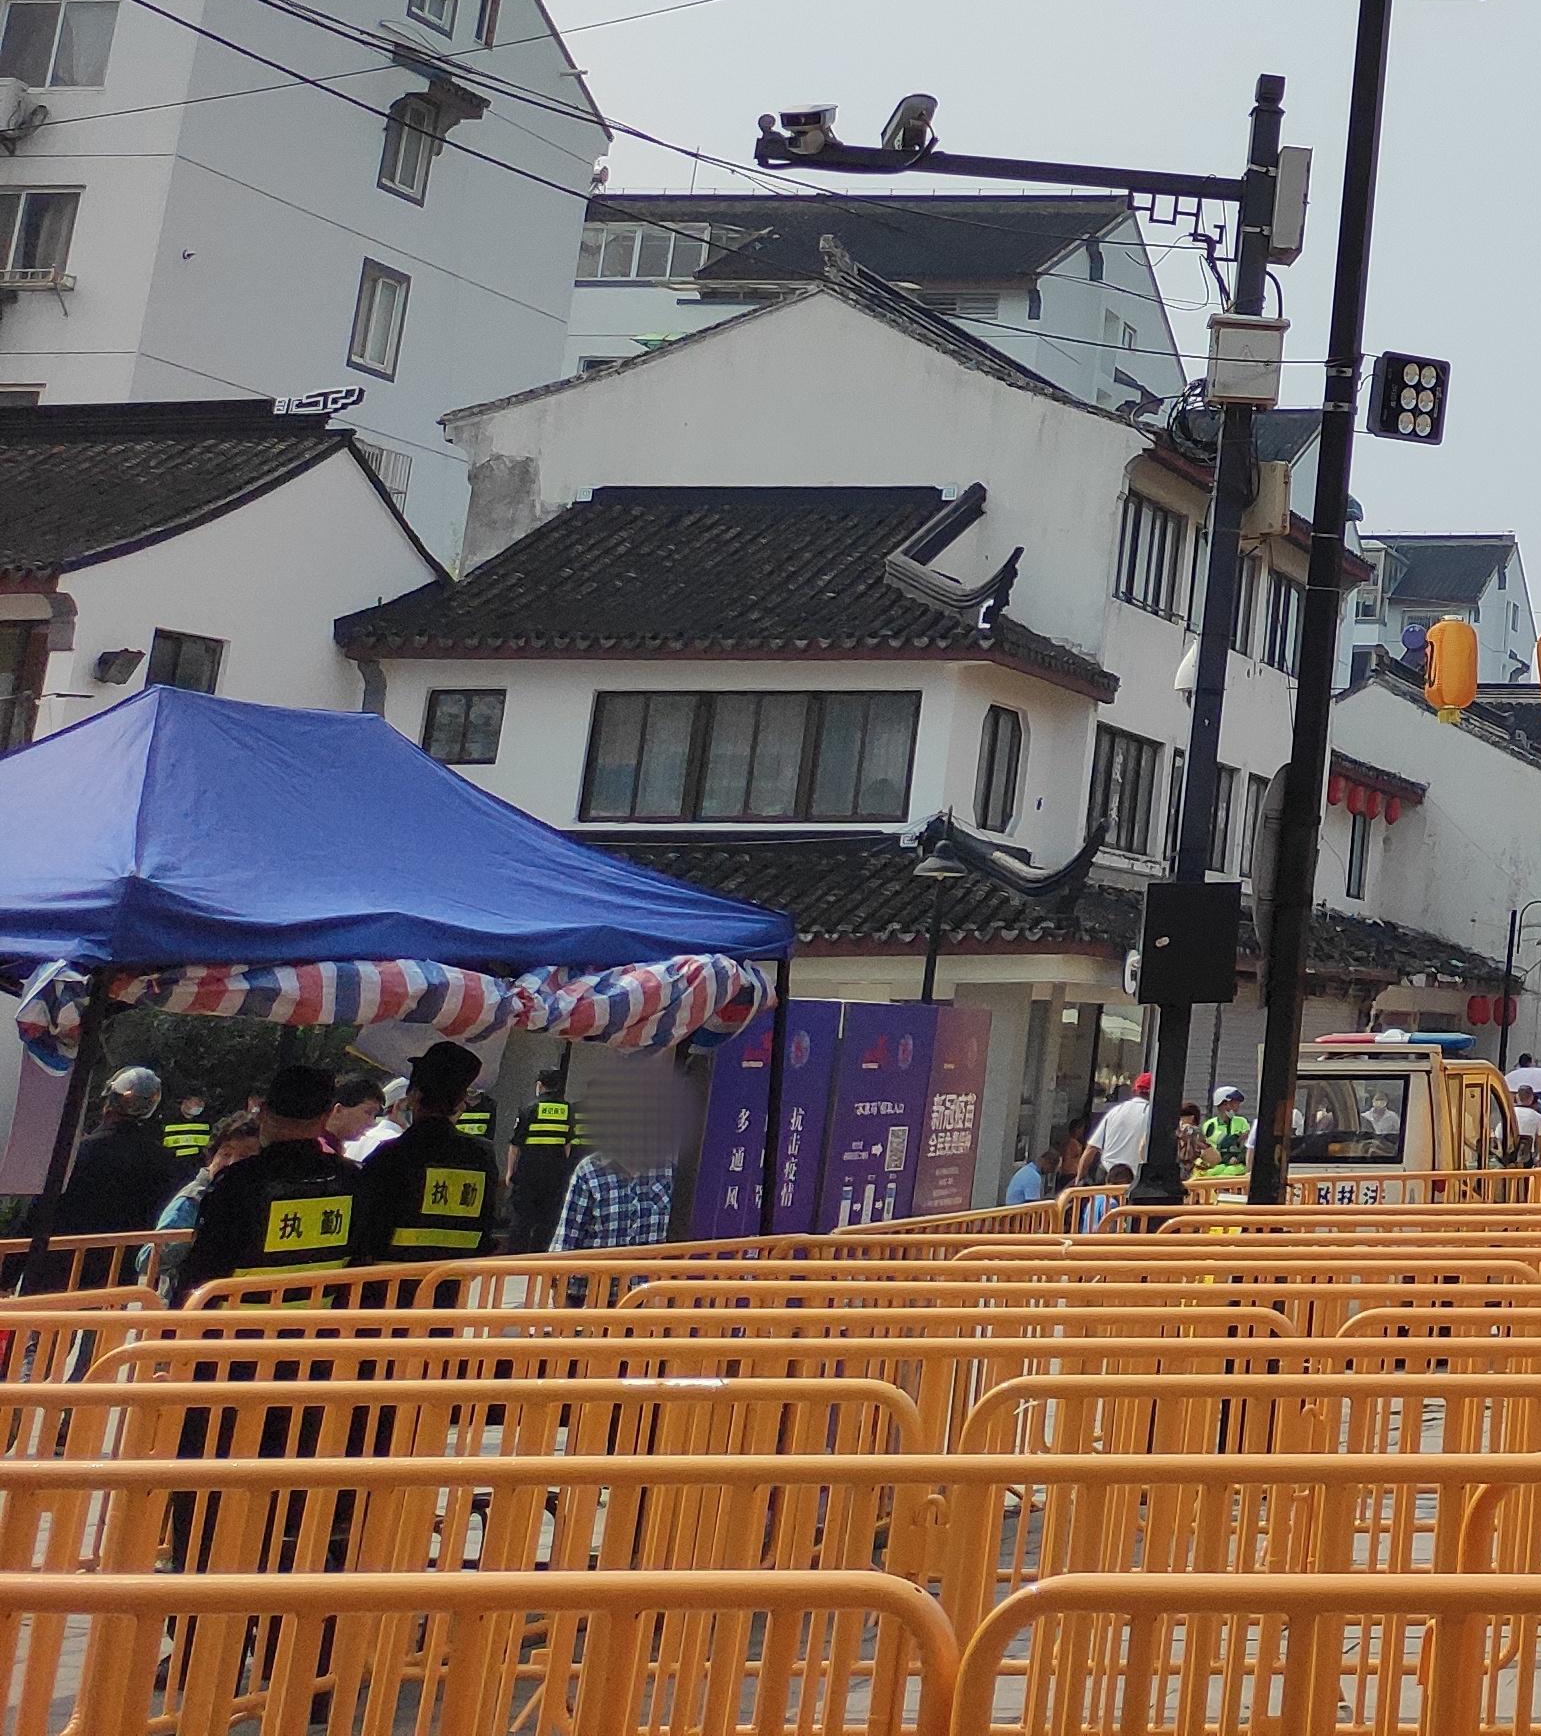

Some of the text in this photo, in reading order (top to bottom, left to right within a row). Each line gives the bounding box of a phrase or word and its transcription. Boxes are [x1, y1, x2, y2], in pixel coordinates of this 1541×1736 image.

[780, 1106, 805, 1207] 抗击疫情
[431, 1180, 477, 1207] 执勤
[279, 1209, 343, 1240] 执勤
